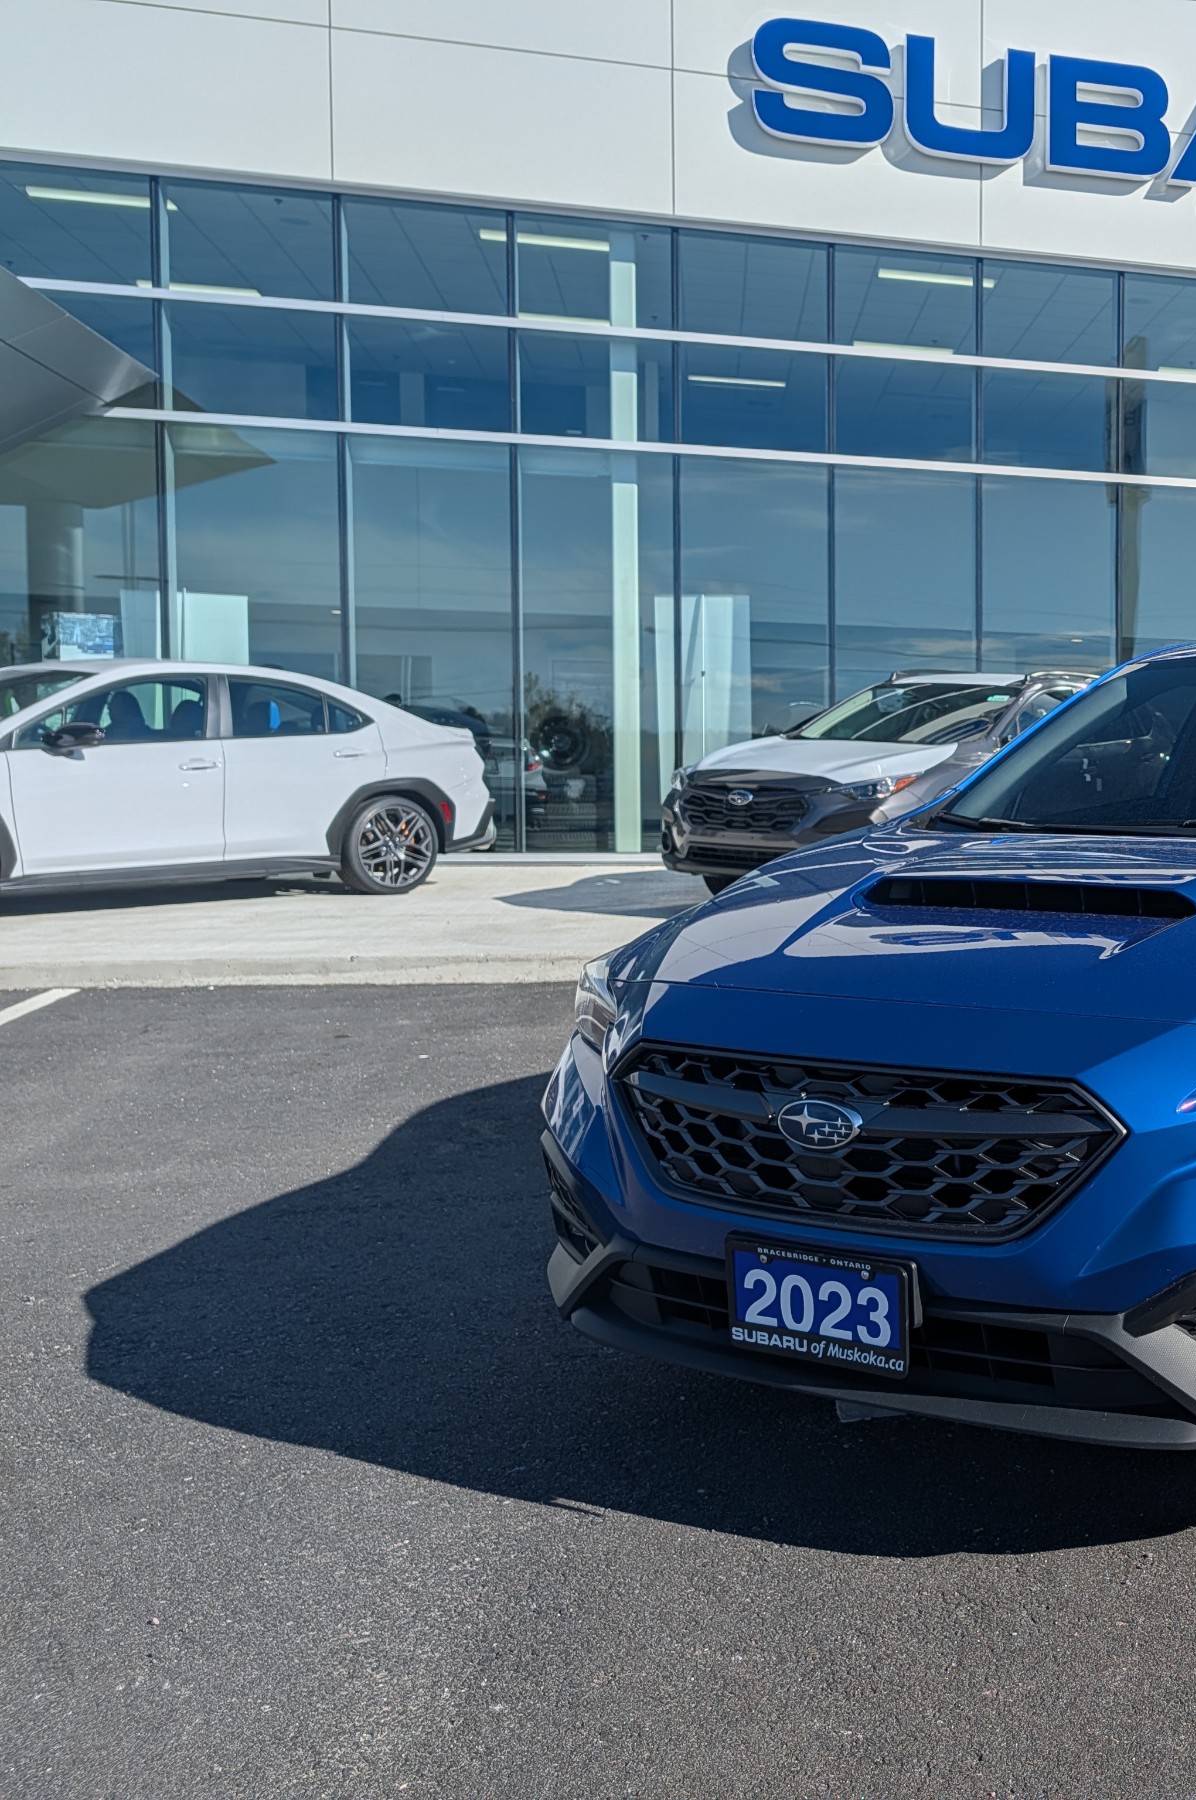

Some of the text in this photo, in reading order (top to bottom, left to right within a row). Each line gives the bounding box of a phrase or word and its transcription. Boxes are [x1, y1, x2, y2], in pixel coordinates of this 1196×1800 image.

[757, 1247, 872, 1271] BRACEBRIDGE ONTARIO
[743, 1268, 892, 1348] 2023
[731, 1326, 905, 1372] SUBARU of Muskoka.ca
